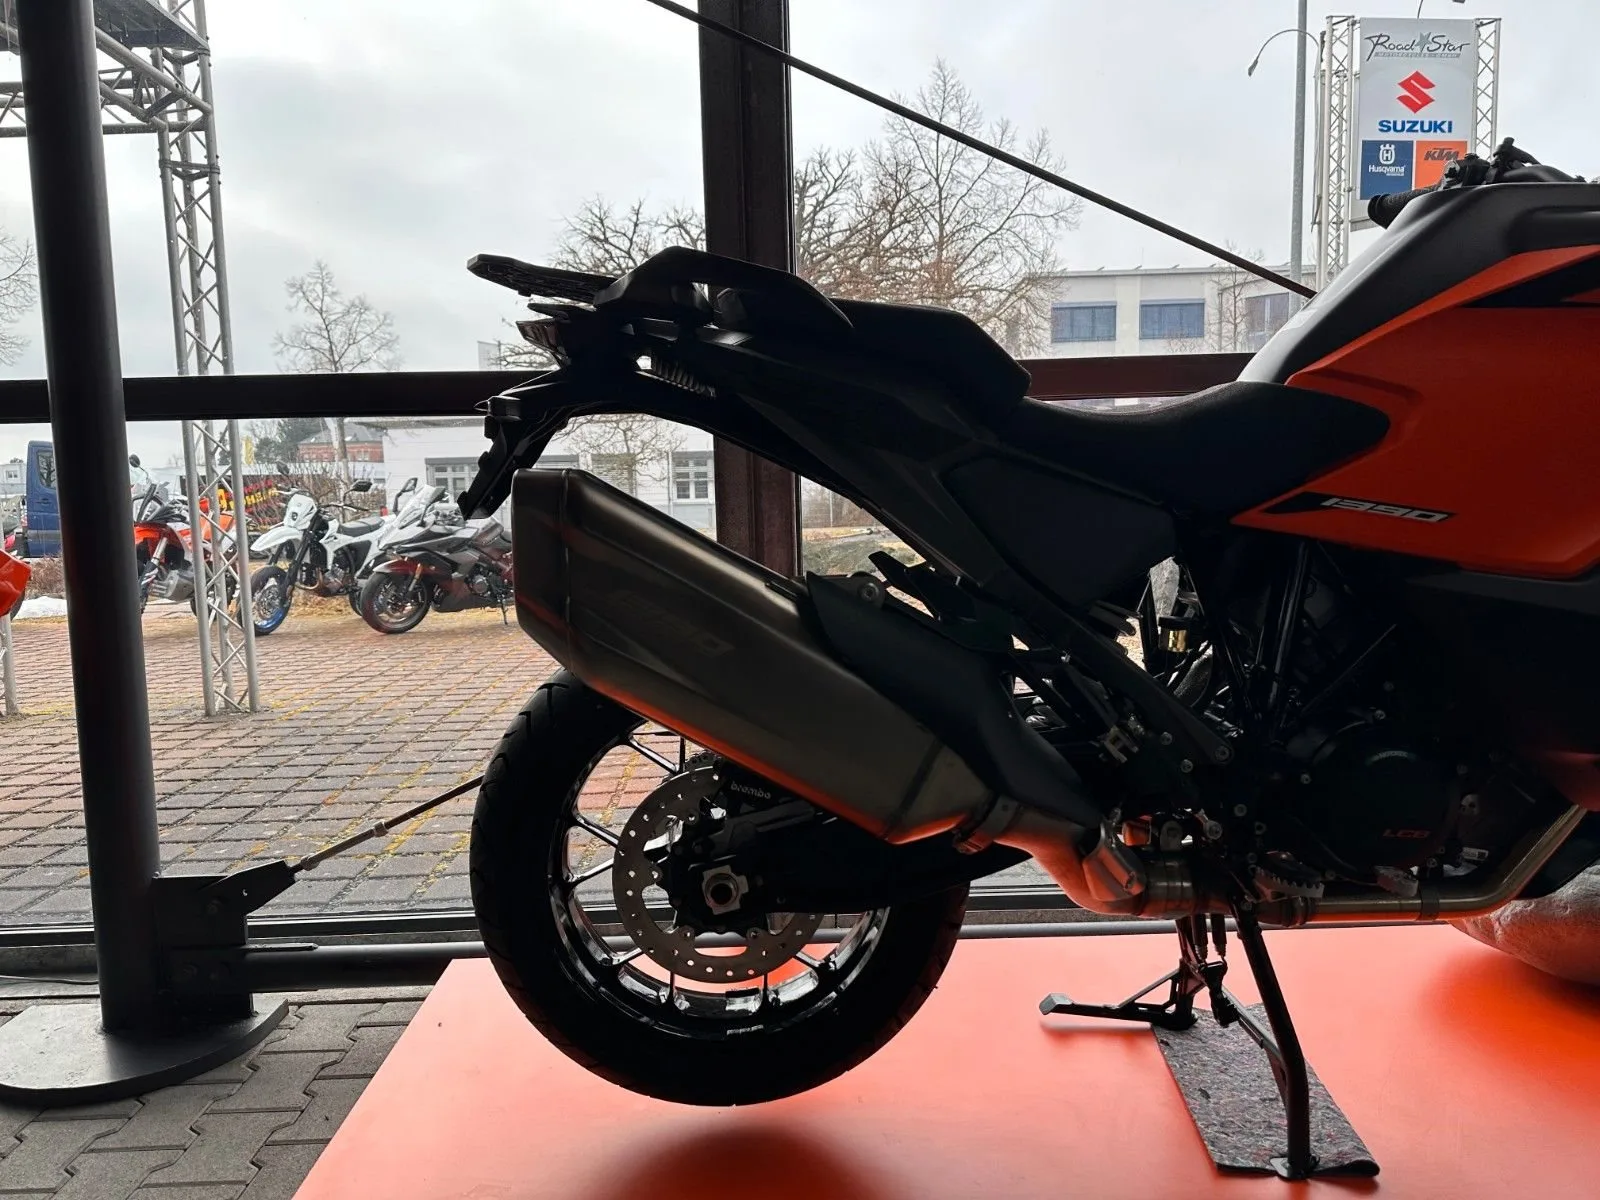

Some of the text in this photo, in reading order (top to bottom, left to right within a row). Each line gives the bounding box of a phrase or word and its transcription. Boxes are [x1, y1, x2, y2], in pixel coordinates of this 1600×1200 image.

[1364, 33, 1470, 61] Road Star
[1378, 119, 1453, 133] SUZUKI
[1424, 148, 1459, 160] KTM
[1369, 165, 1404, 174] Husqvarna
[1320, 497, 1449, 523] 1390
[730, 780, 772, 799] brembo
